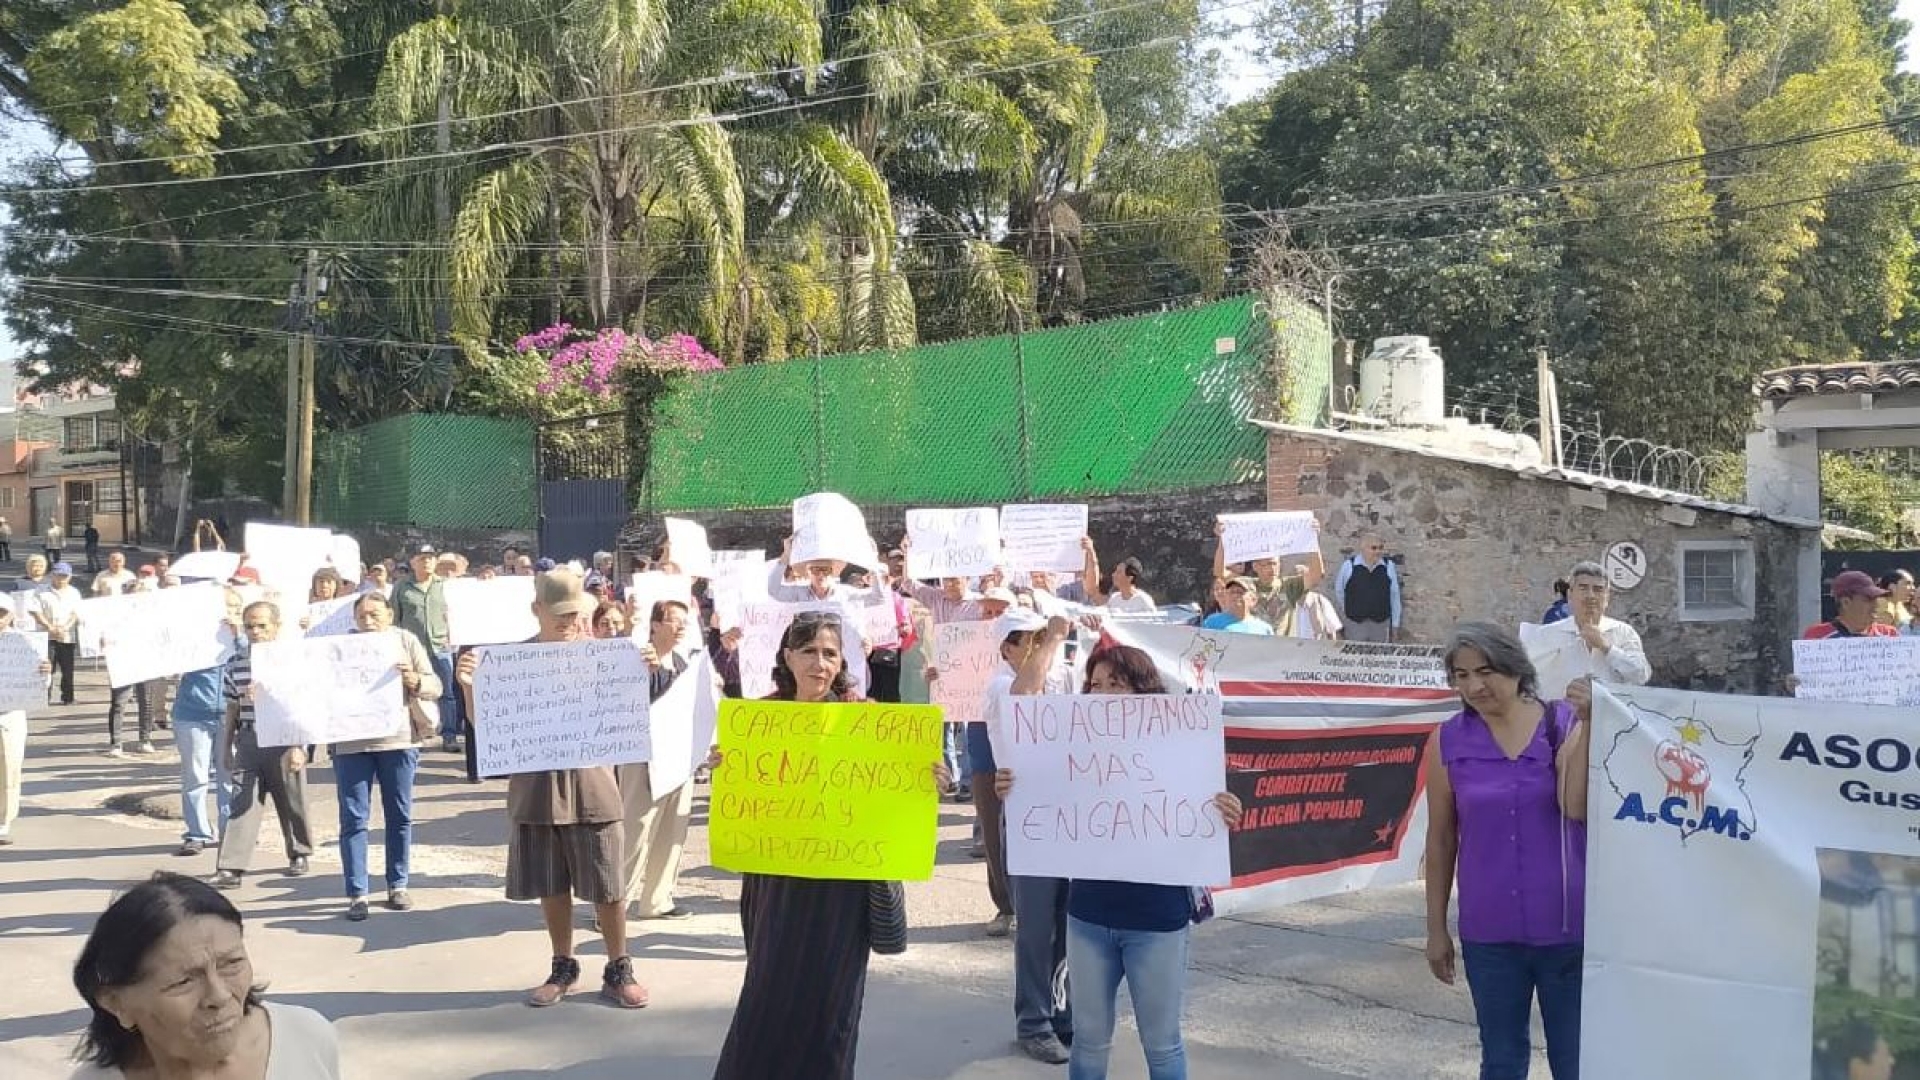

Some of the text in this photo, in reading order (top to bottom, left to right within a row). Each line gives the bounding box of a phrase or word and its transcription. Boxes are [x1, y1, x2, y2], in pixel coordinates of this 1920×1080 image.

[730, 705, 838, 739] CARCEL
[849, 711, 867, 736] A
[1015, 697, 1209, 744] NO ACEPTAMOS
[1068, 753, 1154, 787] MAS
[1780, 732, 1920, 774] ASO
[1255, 773, 1348, 798] COMBATIENTE
[721, 792, 827, 821] CAPELLA
[1242, 807, 1259, 830] LA
[1260, 802, 1301, 828] LUCHA
[1302, 799, 1364, 821] POPULAR
[1614, 791, 1751, 841] A.C.M.
[722, 830, 888, 867] DIPUTADOS
